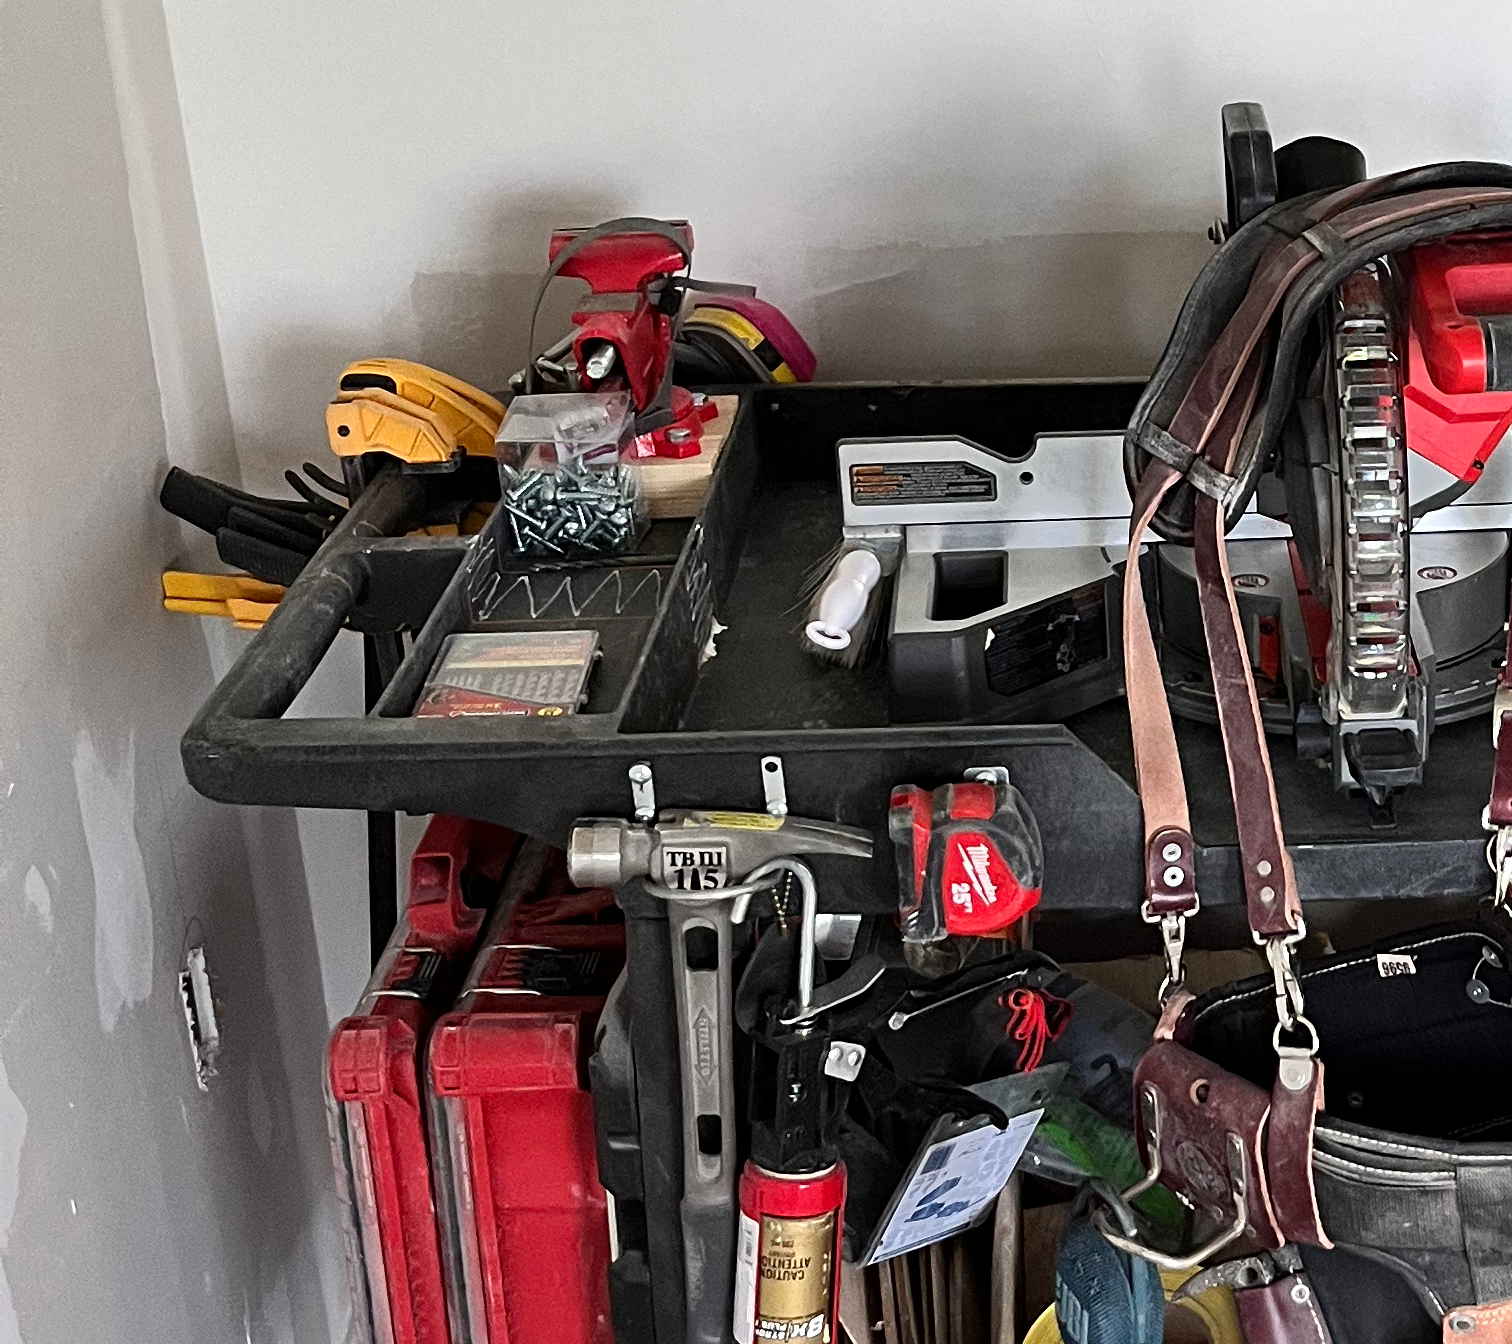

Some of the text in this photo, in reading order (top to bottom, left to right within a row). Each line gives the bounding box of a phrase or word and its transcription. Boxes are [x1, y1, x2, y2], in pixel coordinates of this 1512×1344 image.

[666, 851, 695, 867] TB
[966, 842, 999, 906] Milwaukee
[761, 1256, 812, 1269] ATTENTIO
